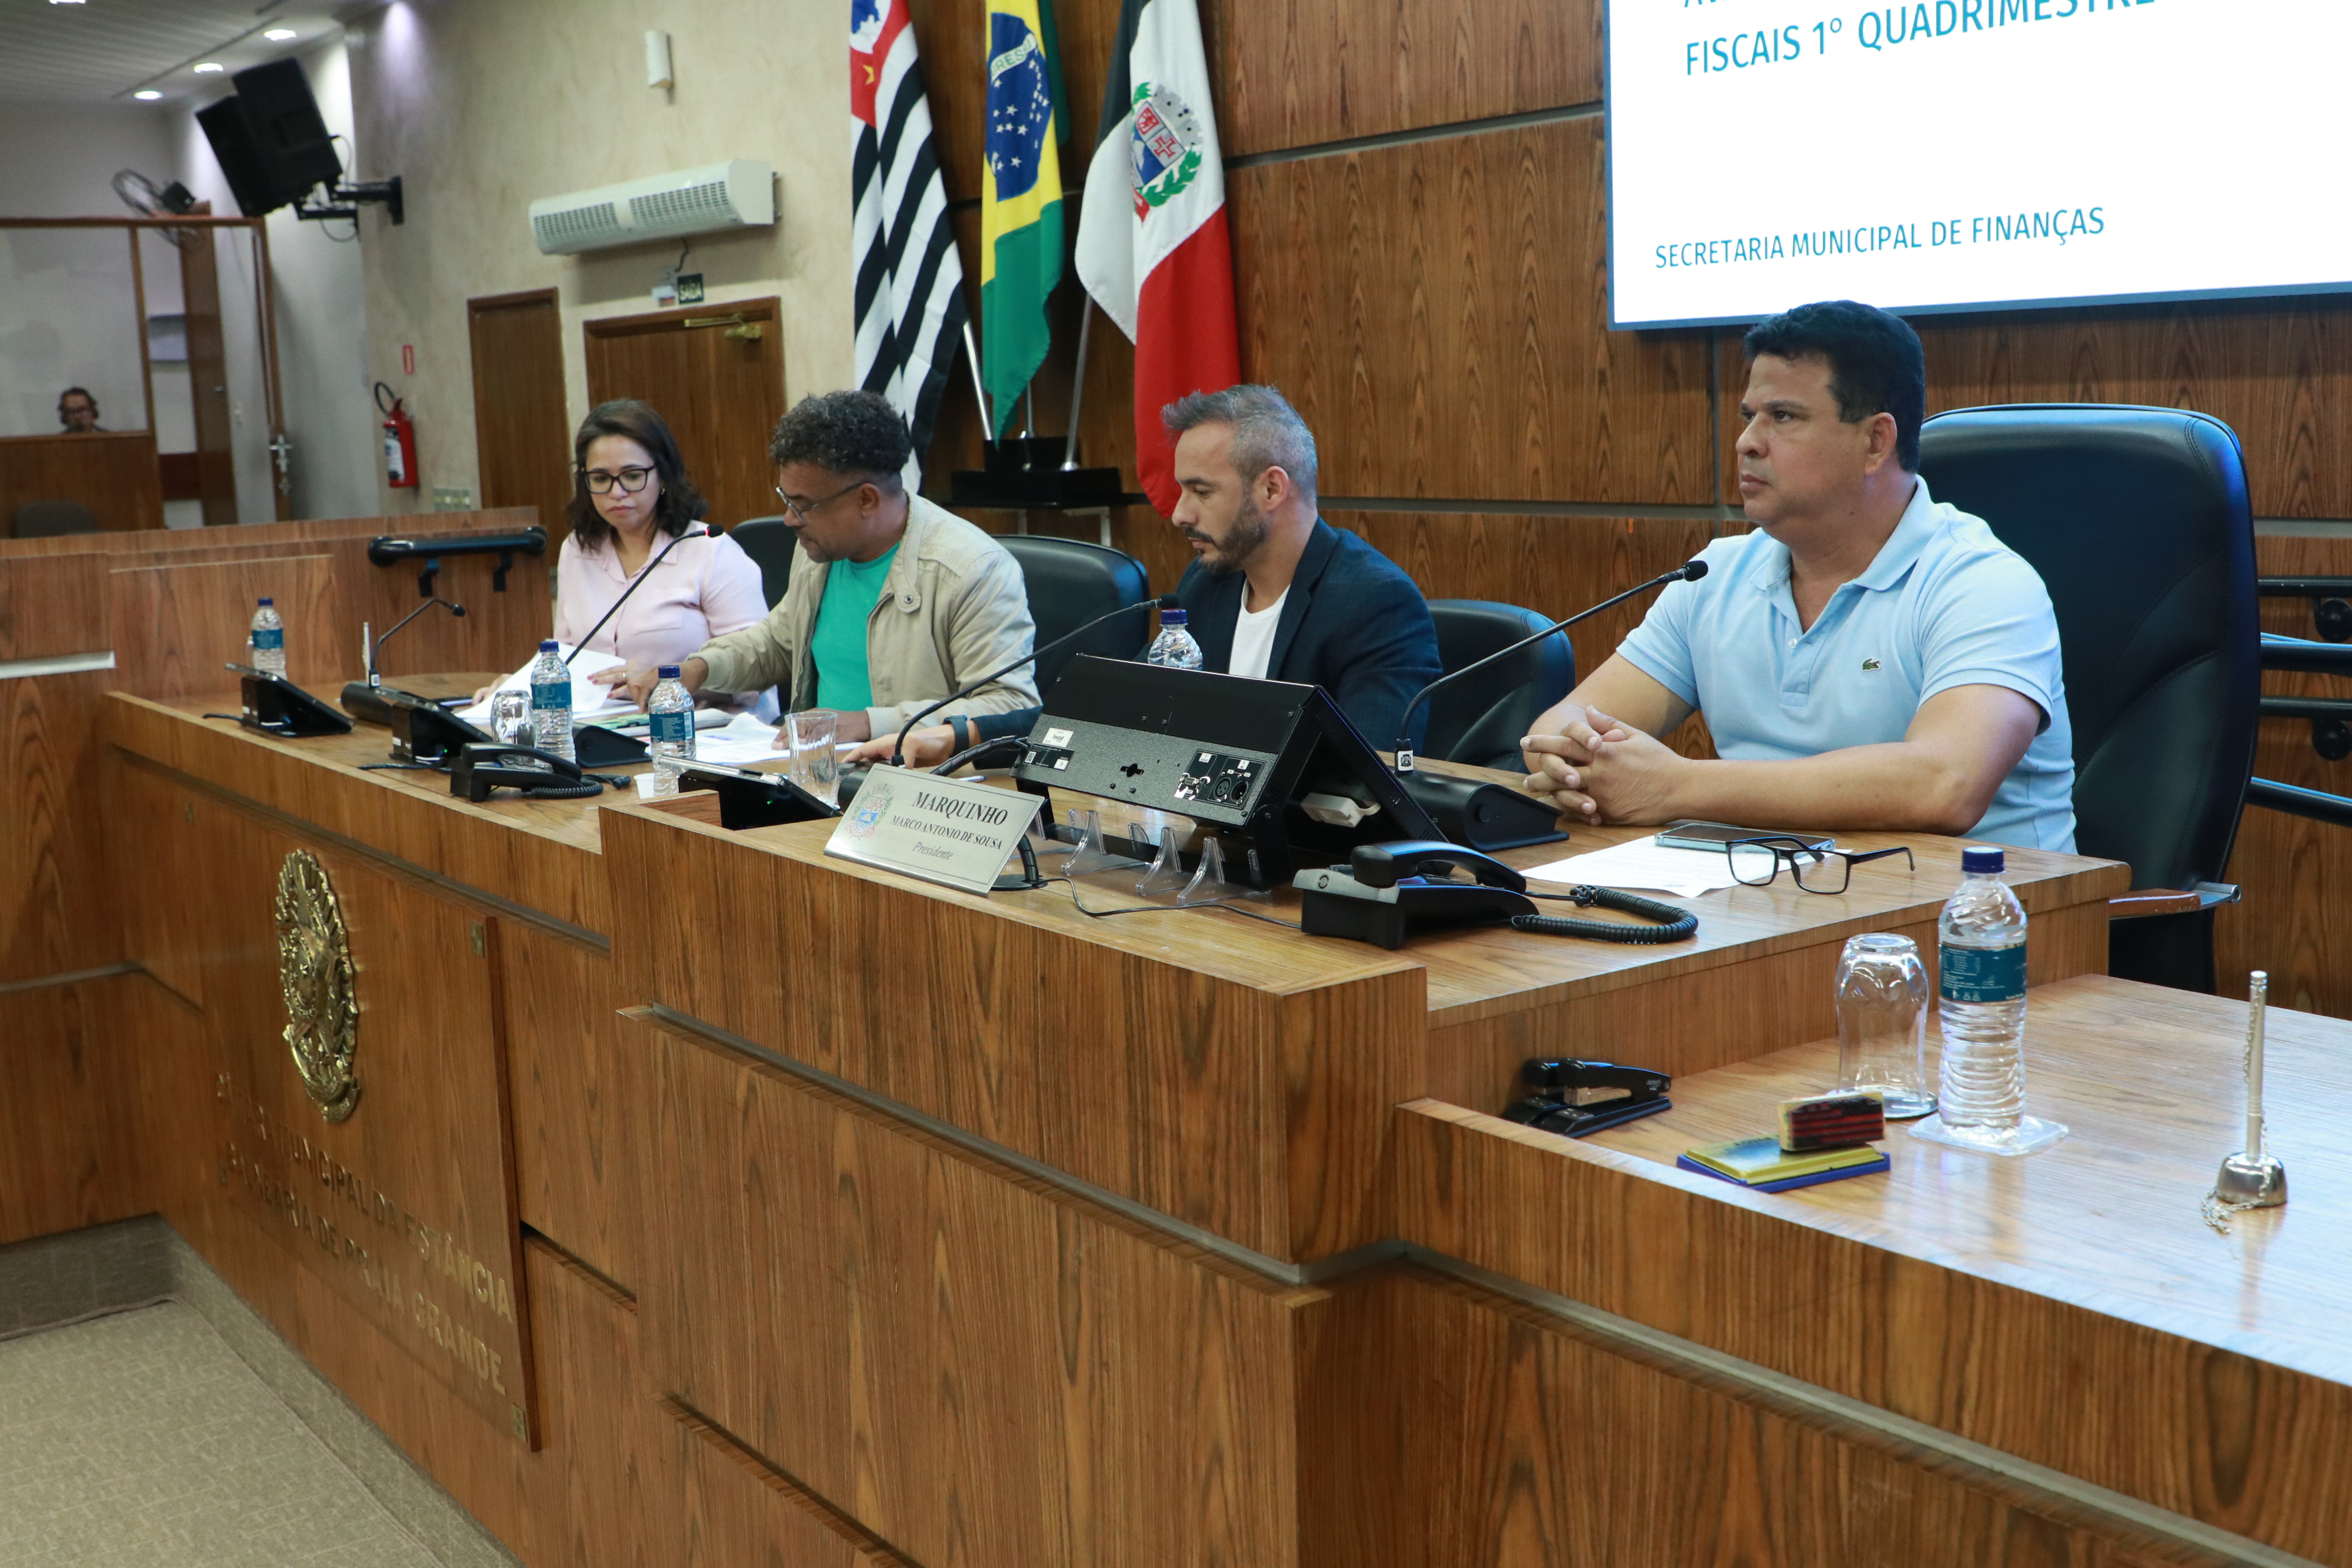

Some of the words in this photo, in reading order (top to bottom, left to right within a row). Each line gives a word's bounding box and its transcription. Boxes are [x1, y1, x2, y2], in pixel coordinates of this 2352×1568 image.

[1687, 25, 1801, 76] FISCAIS
[1858, 0, 2156, 52] QUADRIME
[1655, 234, 1785, 269] SECRETARIA
[1792, 223, 1923, 257] MUNICIPAL
[1931, 219, 1962, 247] DE
[1972, 206, 2105, 246] FINANÇAS
[890, 816, 922, 830] MARCO
[921, 823, 961, 839] ANTONIO
[960, 832, 974, 842] DE
[974, 834, 1002, 850] SOUSA
[911, 792, 1008, 825] MARQUINHO
[912, 841, 953, 860] Presidente
[280, 1119, 370, 1218] MUNICIPAL
[373, 1188, 400, 1239] DA
[404, 1211, 513, 1323] ESTÂNCIA
[317, 1214, 341, 1260] DE
[343, 1236, 405, 1317] PRAIA
[413, 1293, 507, 1396] GRANDE
